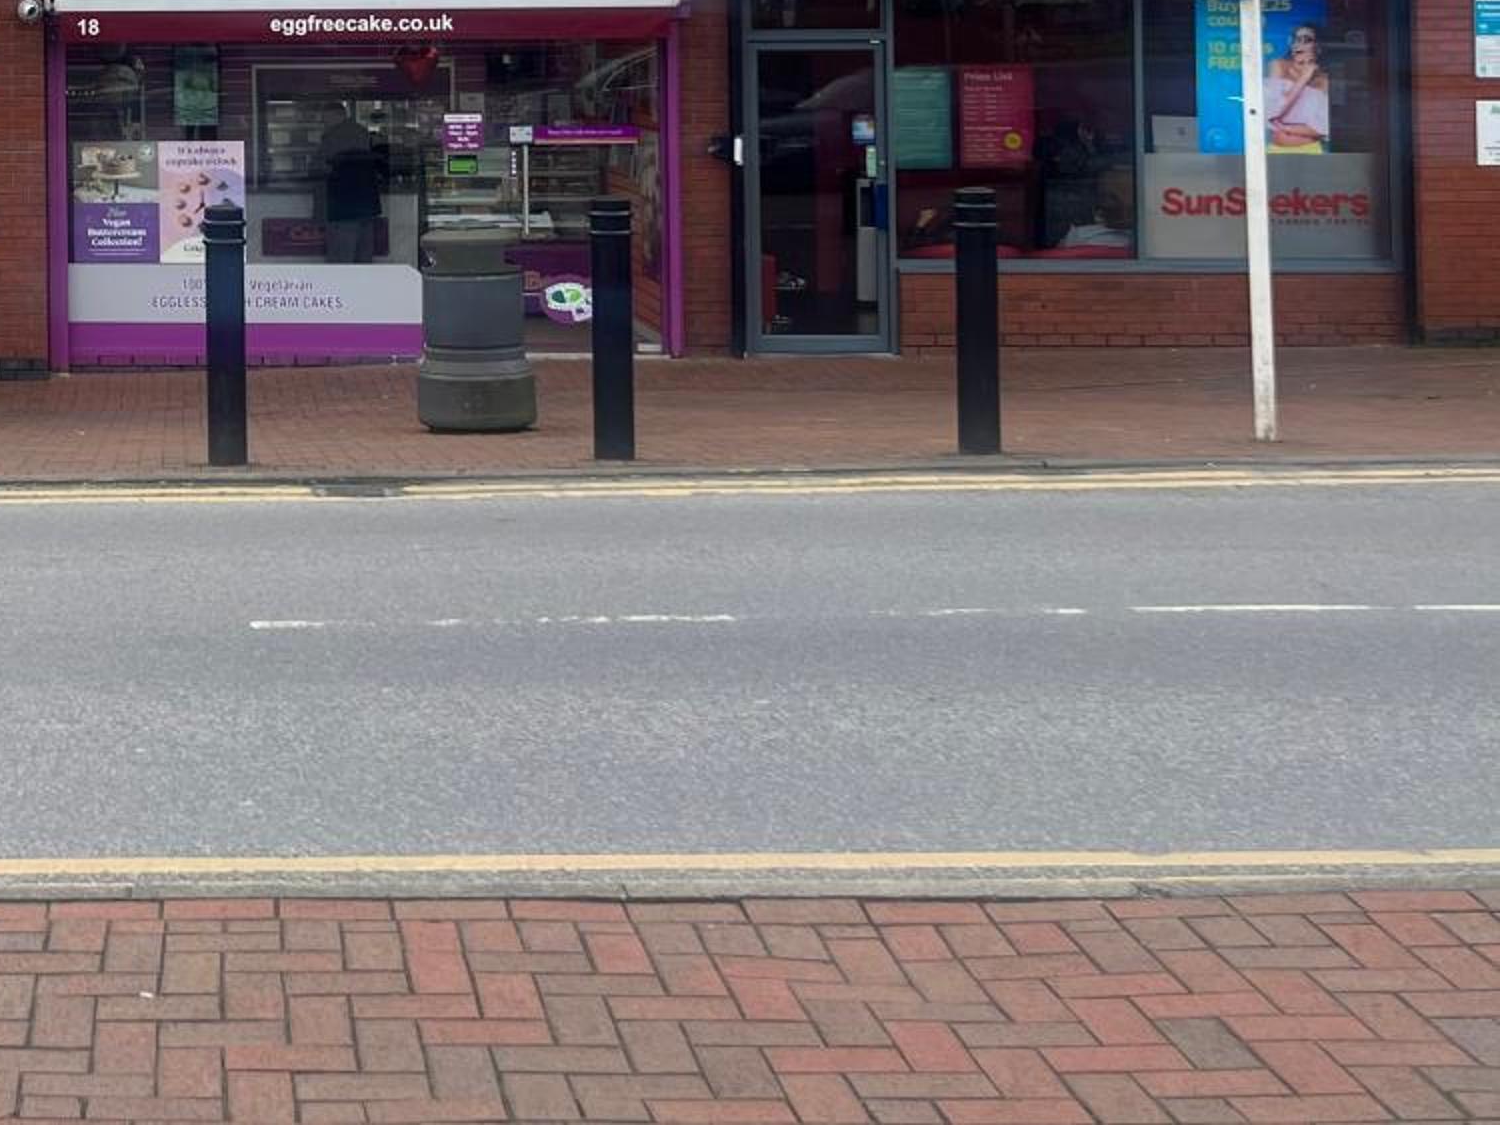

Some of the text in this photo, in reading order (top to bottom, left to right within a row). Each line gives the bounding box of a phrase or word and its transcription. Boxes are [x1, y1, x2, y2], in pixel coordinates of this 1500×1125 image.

[77, 14, 454, 36] 18 eggfreecake.co.uk
[1208, 56, 1242, 70] FRE
[1161, 187, 1370, 217] SunSekers
[182, 278, 313, 293] 100 Vegetarian
[254, 295, 299, 309] CREAM
[303, 295, 344, 309] CAKES
